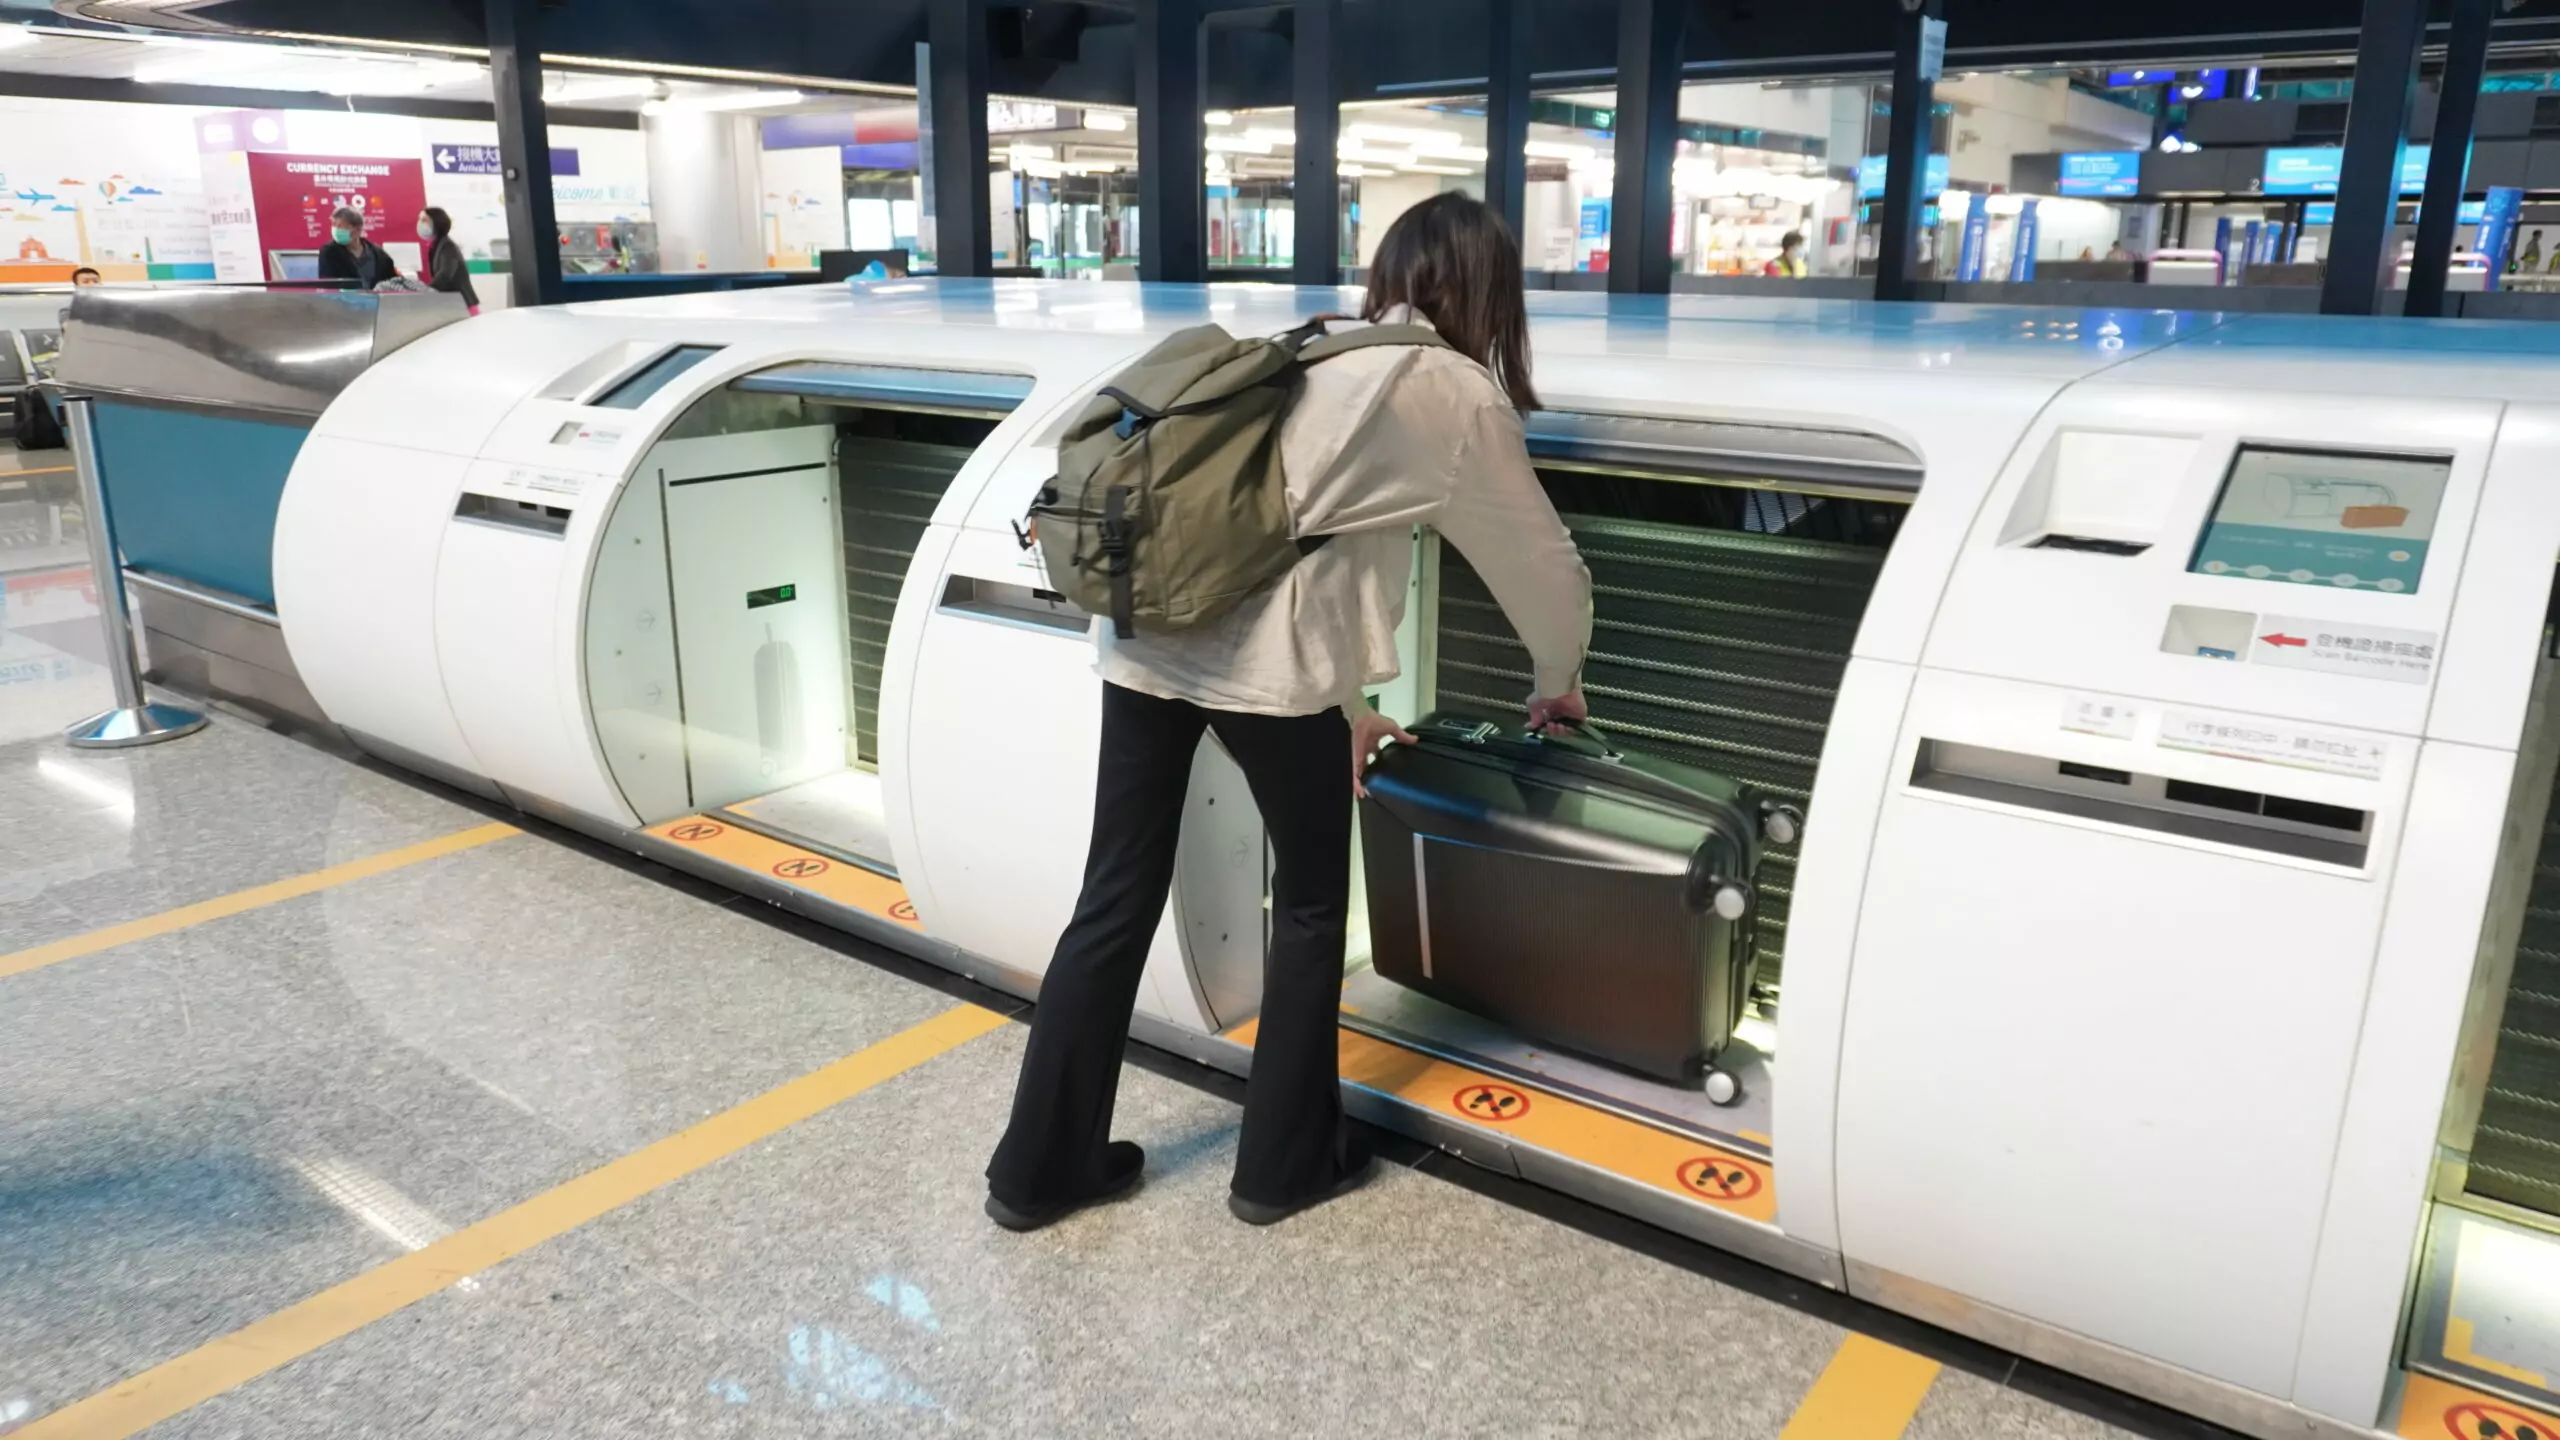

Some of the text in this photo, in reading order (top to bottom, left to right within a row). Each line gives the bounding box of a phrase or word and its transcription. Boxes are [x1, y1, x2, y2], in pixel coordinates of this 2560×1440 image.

[287, 162, 390, 176] CURRENCY EXCHANGE
[458, 161, 485, 172] Arrival
